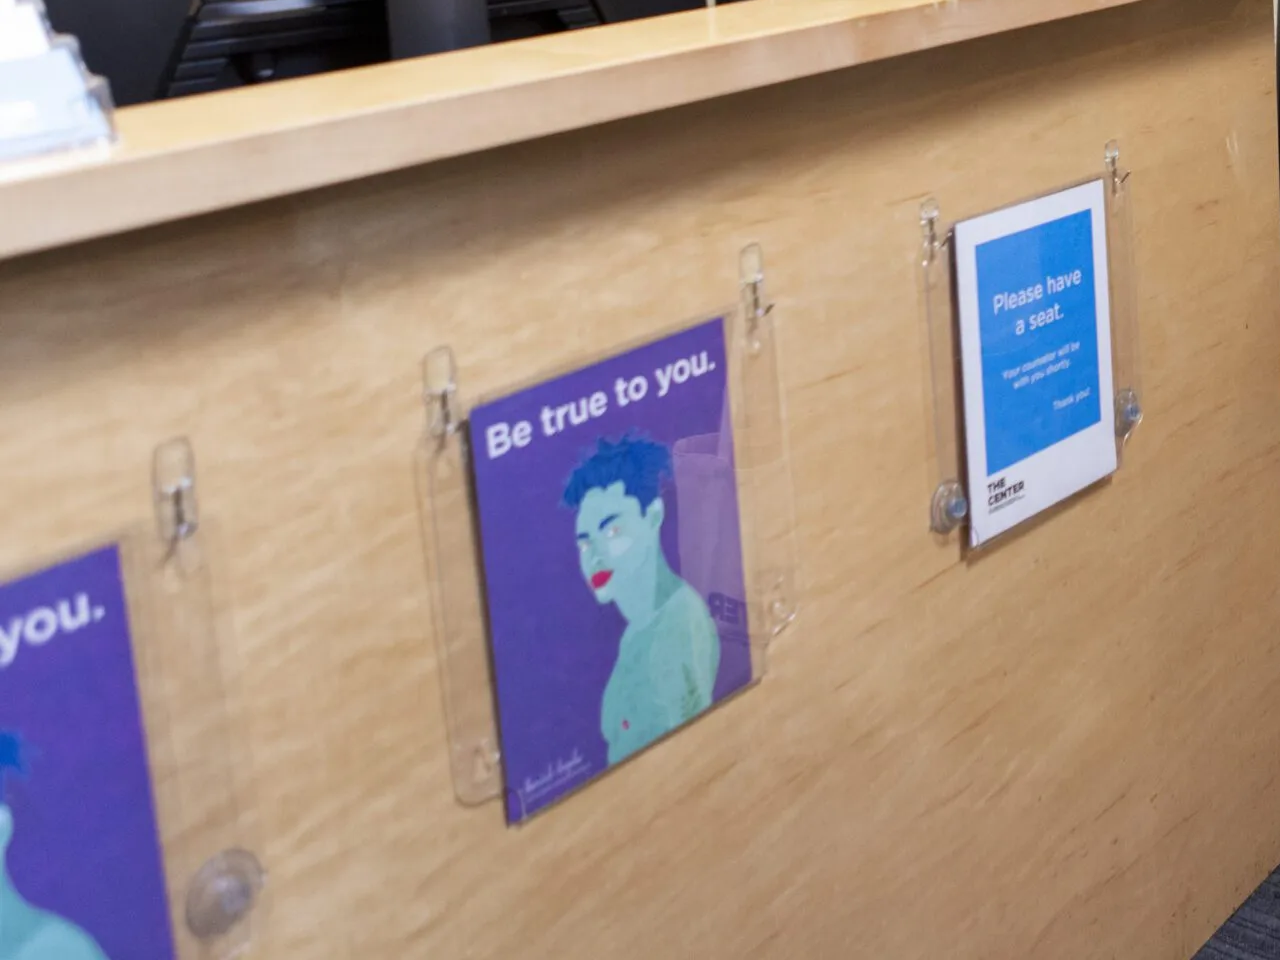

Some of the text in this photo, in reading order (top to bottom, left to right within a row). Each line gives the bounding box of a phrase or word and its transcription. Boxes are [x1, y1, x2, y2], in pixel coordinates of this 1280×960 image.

[993, 269, 1082, 315] Please have
[1015, 302, 1064, 335] a seat.
[1058, 343, 1070, 357] will
[1070, 341, 1081, 352] be
[1030, 372, 1045, 385] you
[485, 348, 716, 458] Be true to you.
[1053, 393, 1074, 410] Thank
[988, 477, 1005, 493] THE
[988, 480, 1025, 506] CENTER
[0, 592, 106, 668] you.
